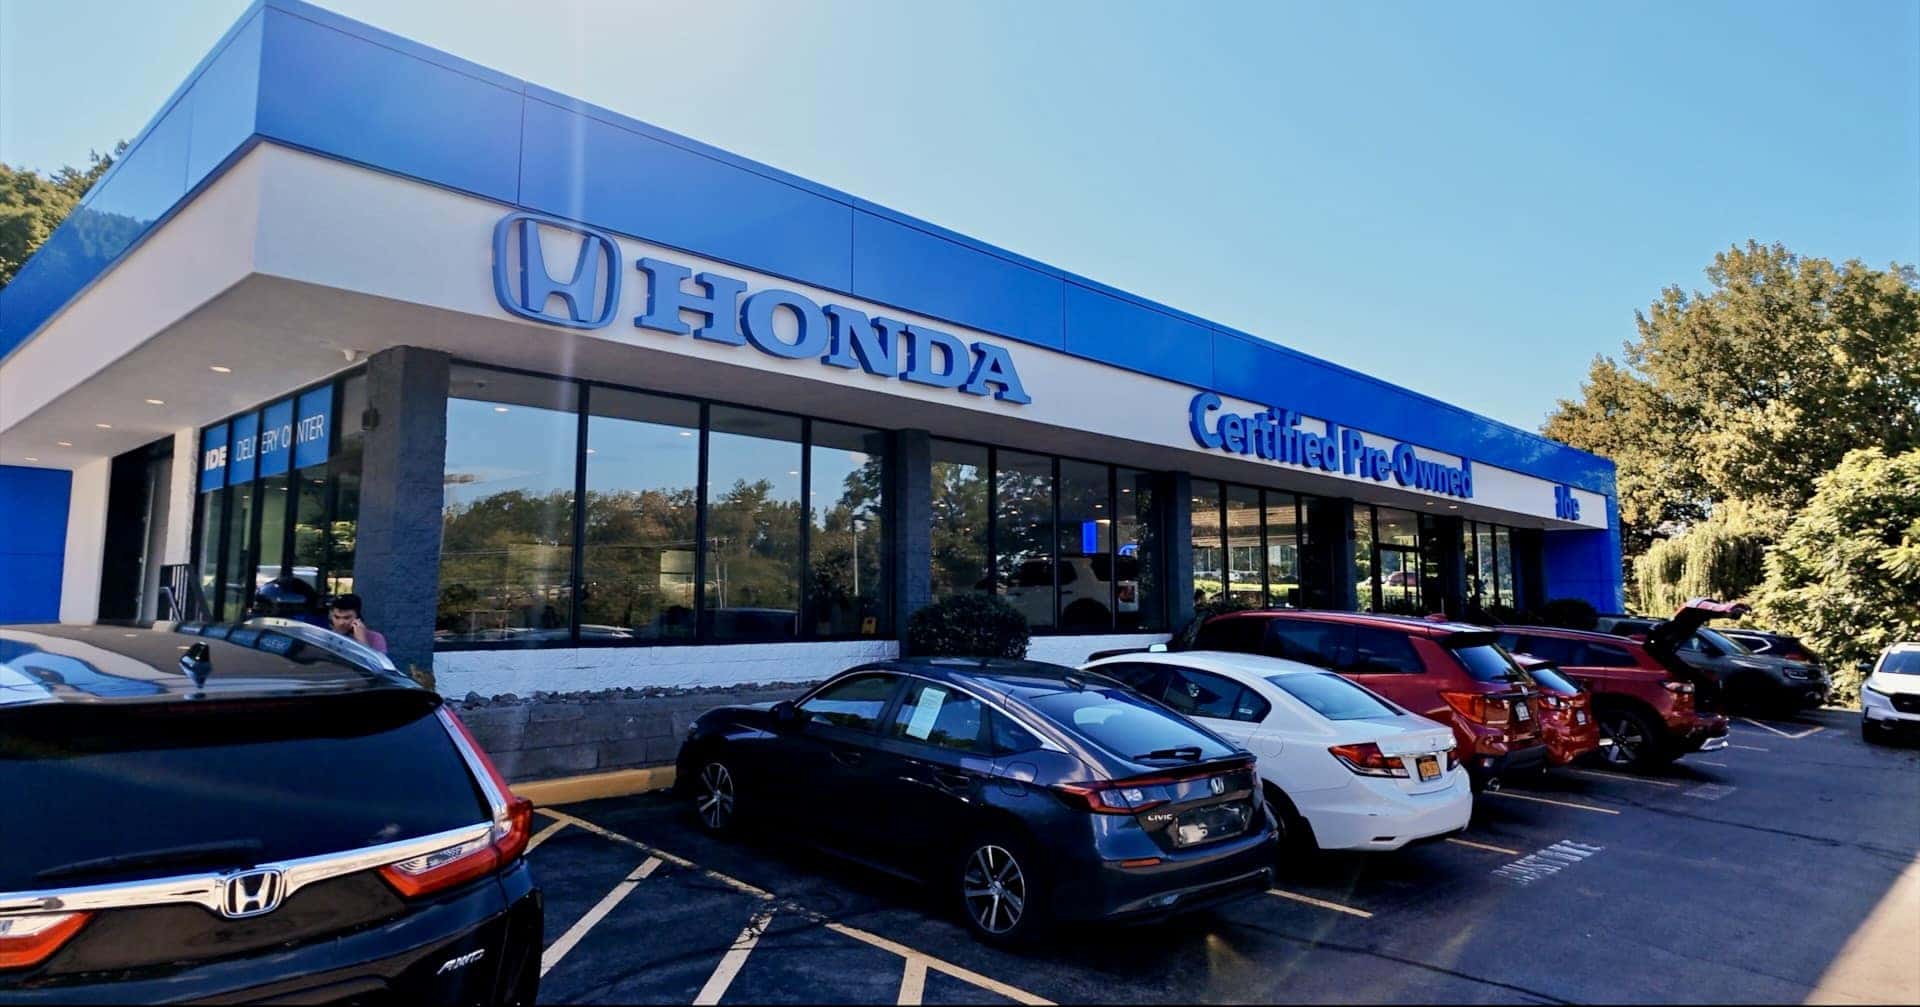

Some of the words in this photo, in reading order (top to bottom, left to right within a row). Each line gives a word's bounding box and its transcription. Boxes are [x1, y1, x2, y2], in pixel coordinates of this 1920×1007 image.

[634, 257, 1031, 404] HONDA
[205, 445, 227, 471] IDE
[236, 427, 281, 462] DELIERY
[281, 414, 325, 449] CNTER
[1189, 391, 1340, 472] Certified
[1342, 427, 1473, 498] Pre-Owned
[1147, 813, 1174, 821] CIVIC
